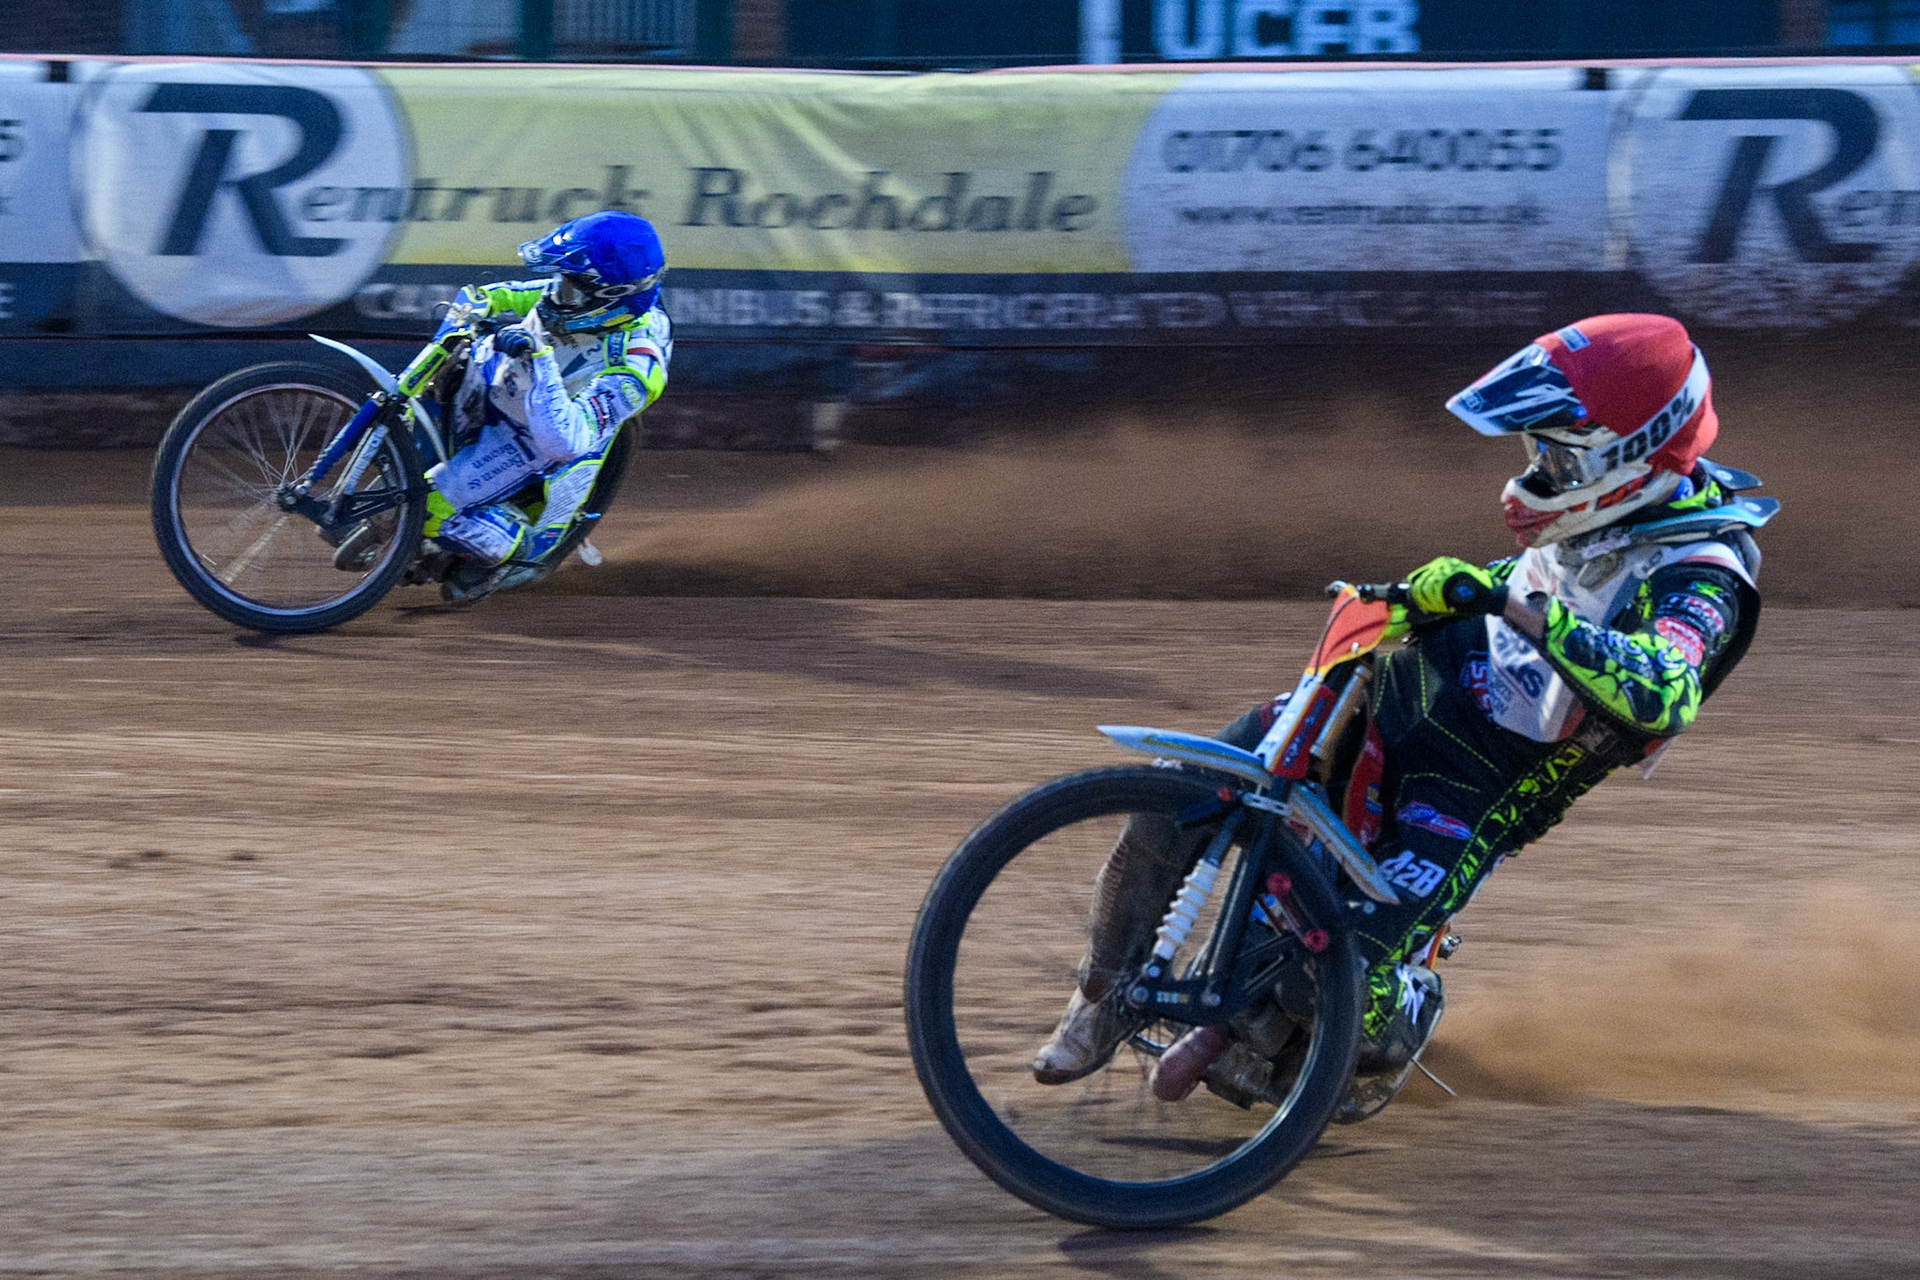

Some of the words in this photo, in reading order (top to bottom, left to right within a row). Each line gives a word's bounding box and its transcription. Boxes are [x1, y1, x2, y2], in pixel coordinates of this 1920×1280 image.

[1343, 127, 1562, 172] 640055
[676, 166, 1098, 232] Rochdale
[471, 443, 518, 469] Brown
[1601, 386, 1696, 473] 100%
